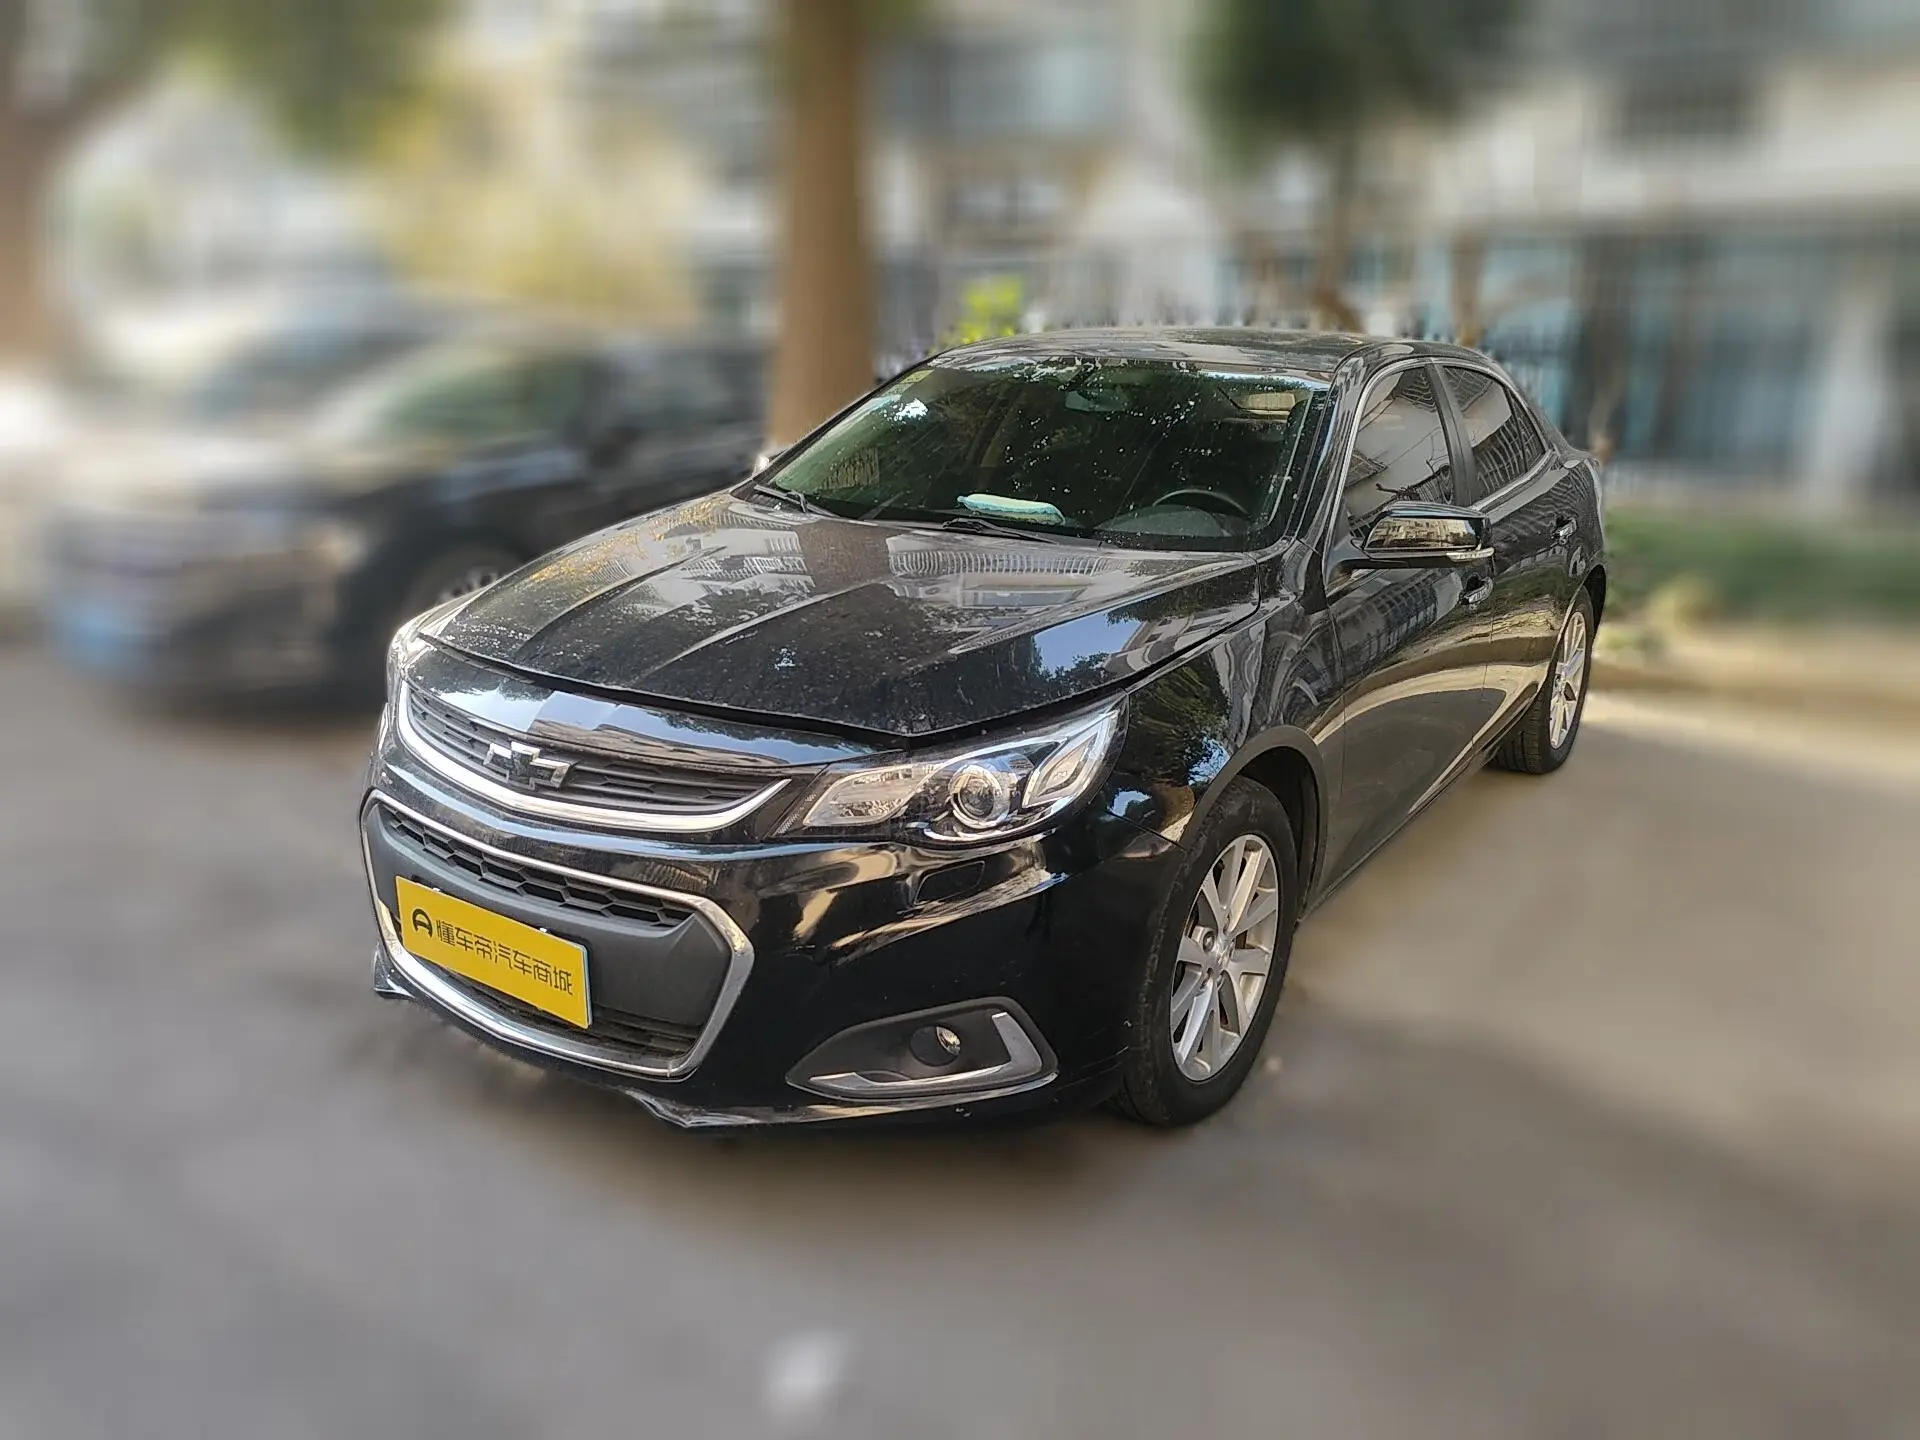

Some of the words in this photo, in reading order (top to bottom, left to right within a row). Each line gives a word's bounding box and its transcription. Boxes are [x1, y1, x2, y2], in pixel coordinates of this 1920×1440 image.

[436, 919, 573, 995] 懂车帝汽车商城
